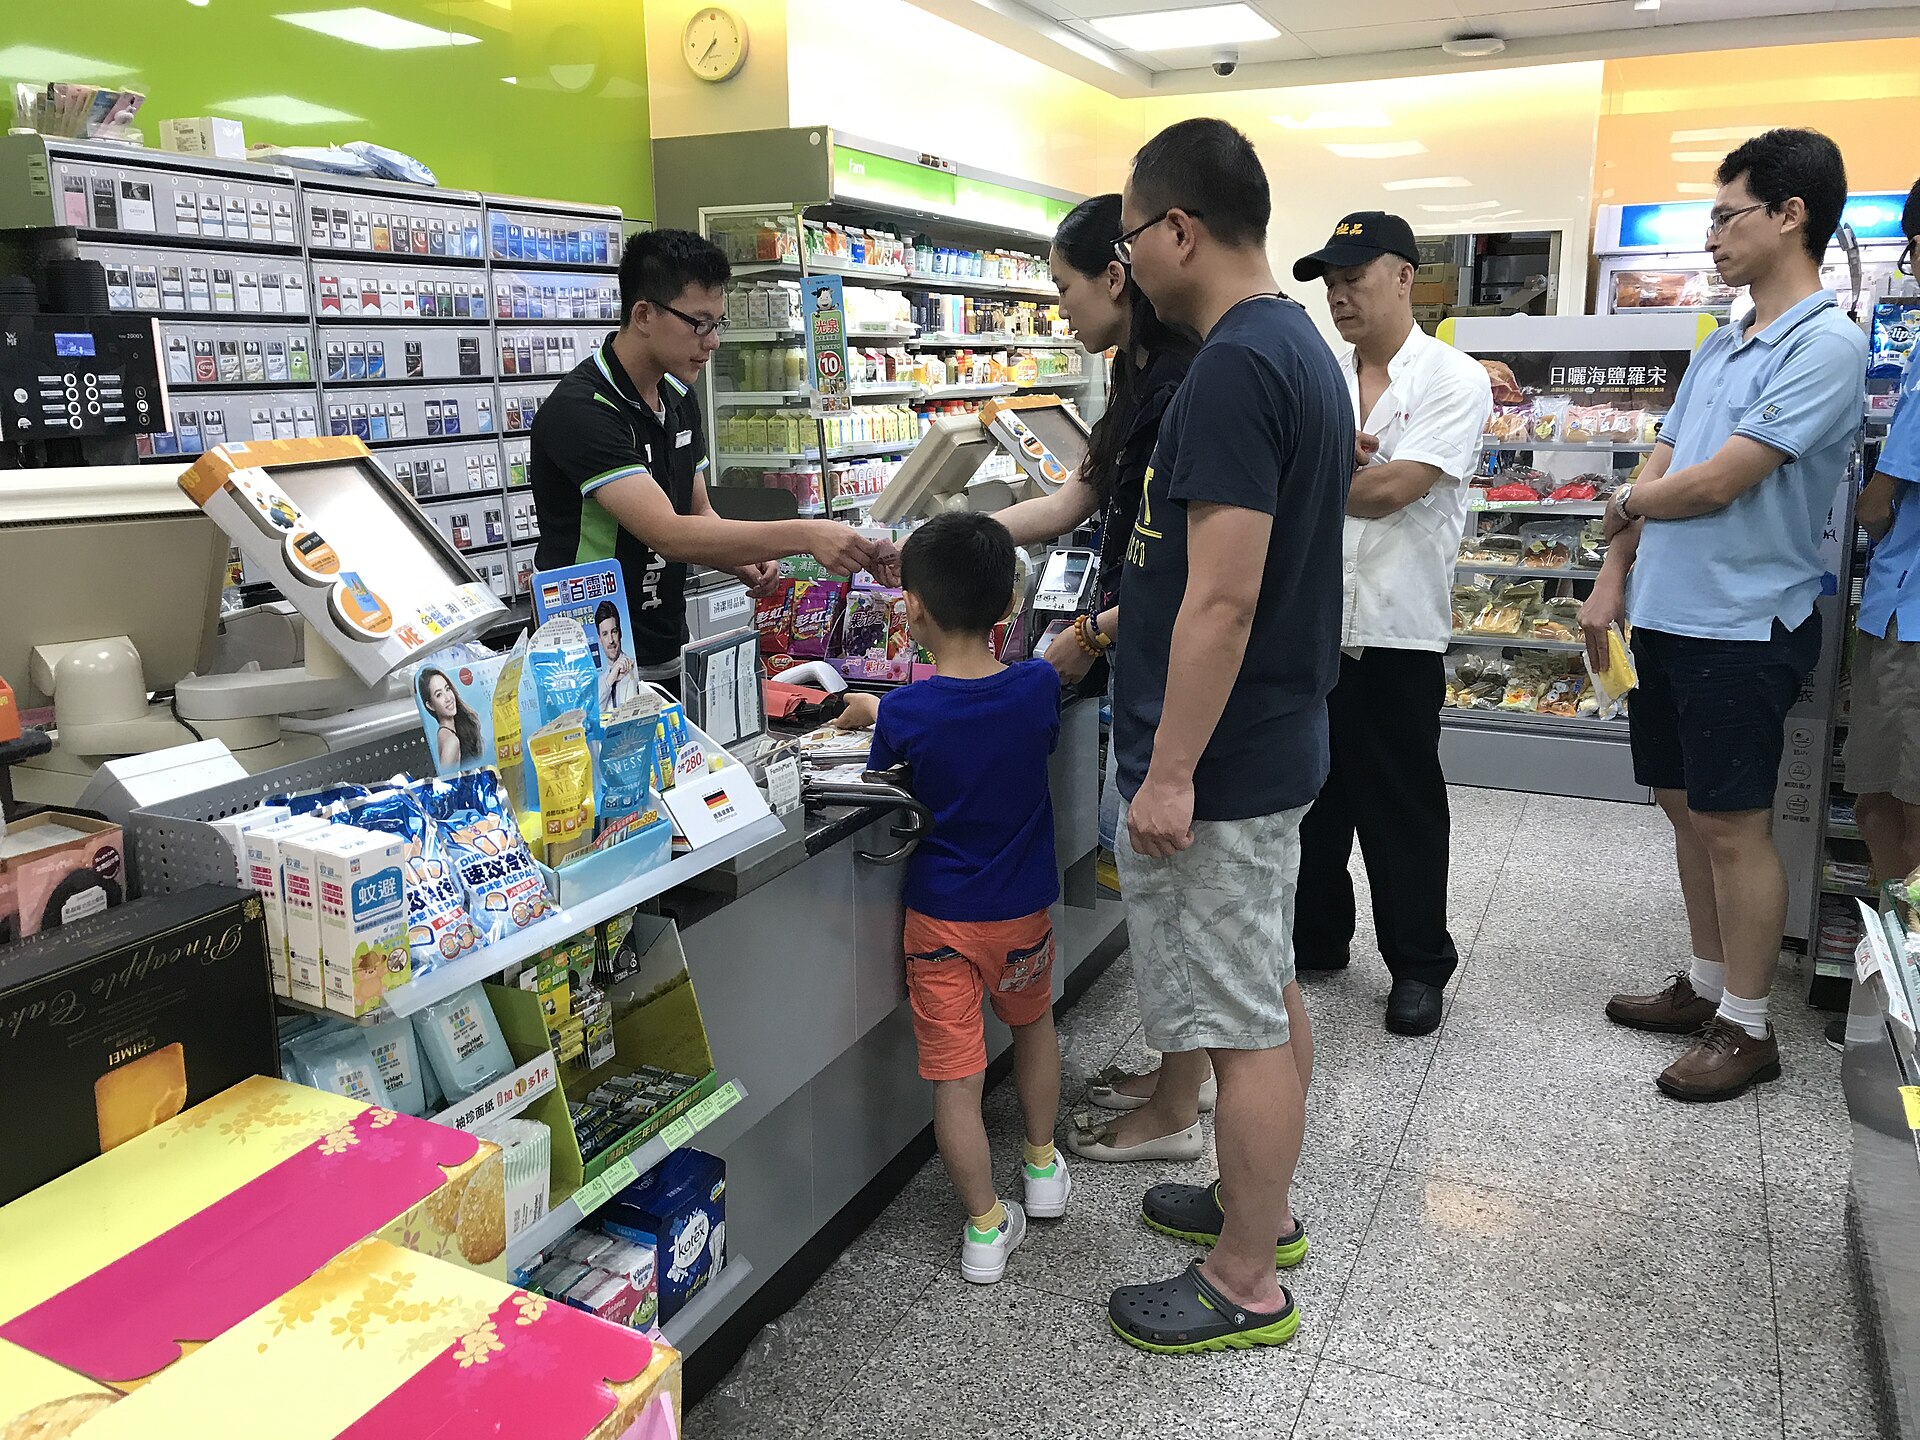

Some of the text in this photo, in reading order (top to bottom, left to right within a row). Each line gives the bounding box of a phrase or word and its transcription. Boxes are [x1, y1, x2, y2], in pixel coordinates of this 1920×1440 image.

[1334, 223, 1364, 235] 極品
[815, 318, 839, 335] 光泉
[821, 358, 839, 377] 10
[1550, 366, 1668, 386] 日曬海鹽羅宋
[568, 571, 617, 602] 百靈油
[397, 627, 425, 650] ME
[684, 752, 703, 774] 280
[769, 761, 793, 775] FamilyMart
[642, 810, 658, 824] 399
[504, 875, 518, 886] ICE
[358, 876, 397, 907] 蚊避
[91, 923, 242, 999] Pineapple
[570, 947, 583, 957] GP
[538, 977, 552, 991] GP
[108, 1036, 157, 1066] CHIMEI
[456, 1033, 483, 1054] FamilyMart
[460, 1041, 485, 1059] collection
[455, 1098, 495, 1130] 袖珍面紙
[701, 1100, 714, 1112] 115
[675, 1118, 688, 1131] 115
[619, 1160, 631, 1171] 45
[591, 1181, 602, 1192] 45
[677, 1228, 705, 1259] kotex
